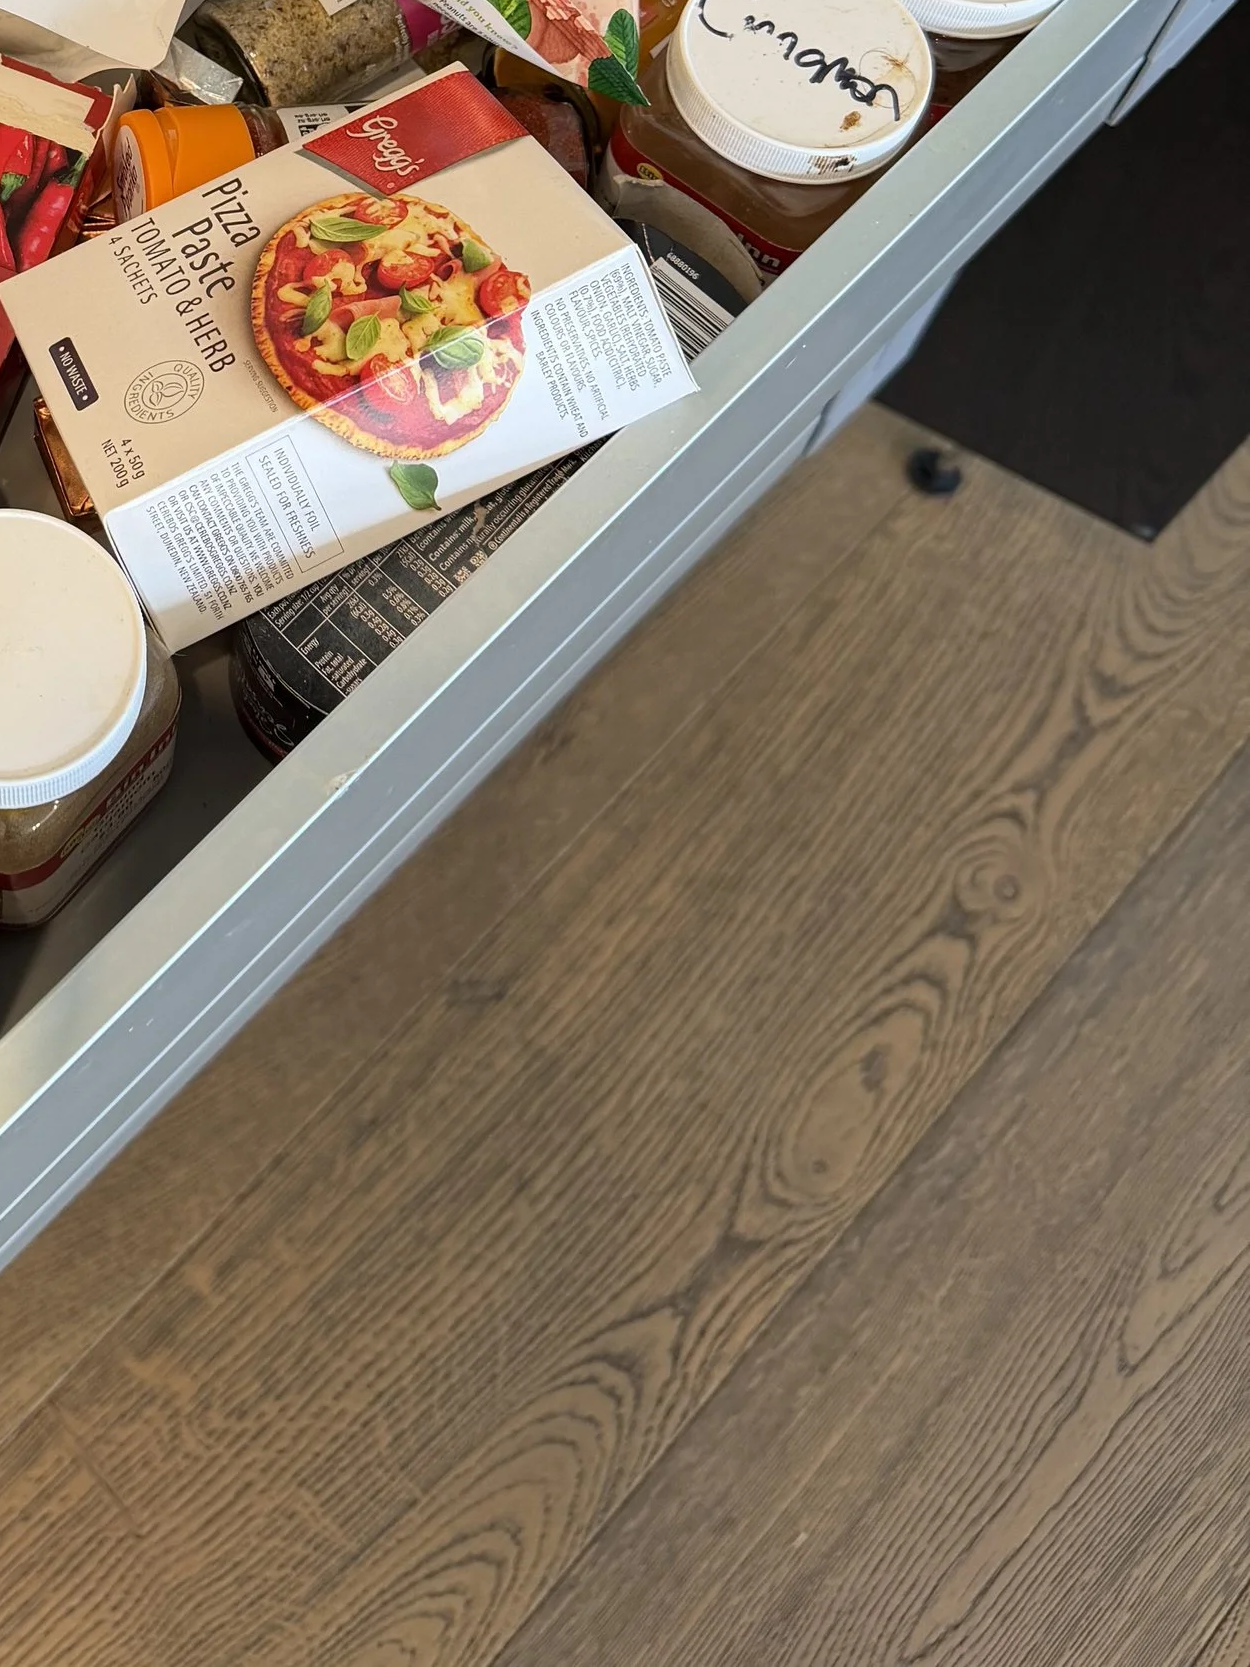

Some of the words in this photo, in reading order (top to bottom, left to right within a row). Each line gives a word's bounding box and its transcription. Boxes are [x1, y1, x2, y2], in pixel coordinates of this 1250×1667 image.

[345, 114, 425, 176] Gregg's
[202, 178, 261, 248] Pizza
[106, 233, 123, 246] 4
[131, 217, 191, 295] TOMATO
[172, 217, 235, 298] Paste
[114, 246, 158, 304] SACHETS
[173, 294, 204, 318] &
[621, 263, 648, 317] INGREDIENTS:
[644, 319, 662, 353] TOMATO
[656, 353, 672, 377] PASTE
[59, 350, 75, 366] NO
[185, 312, 236, 372] HERB
[66, 365, 87, 395] WASTE
[124, 371, 174, 424] INGREDIENTS
[174, 360, 205, 399] QUALITY
[101, 439, 118, 458] NET
[119, 437, 133, 448] 4
[123, 446, 134, 456] x
[106, 456, 132, 490] 200g
[274, 448, 311, 509] INDIVIDUALLY
[305, 510, 320, 532] FOIL
[259, 455, 282, 490] SEALED
[277, 491, 291, 510] FOR
[286, 510, 316, 559] FRESHNESS
[297, 636, 320, 657] Energy
[312, 650, 336, 671] Protein
